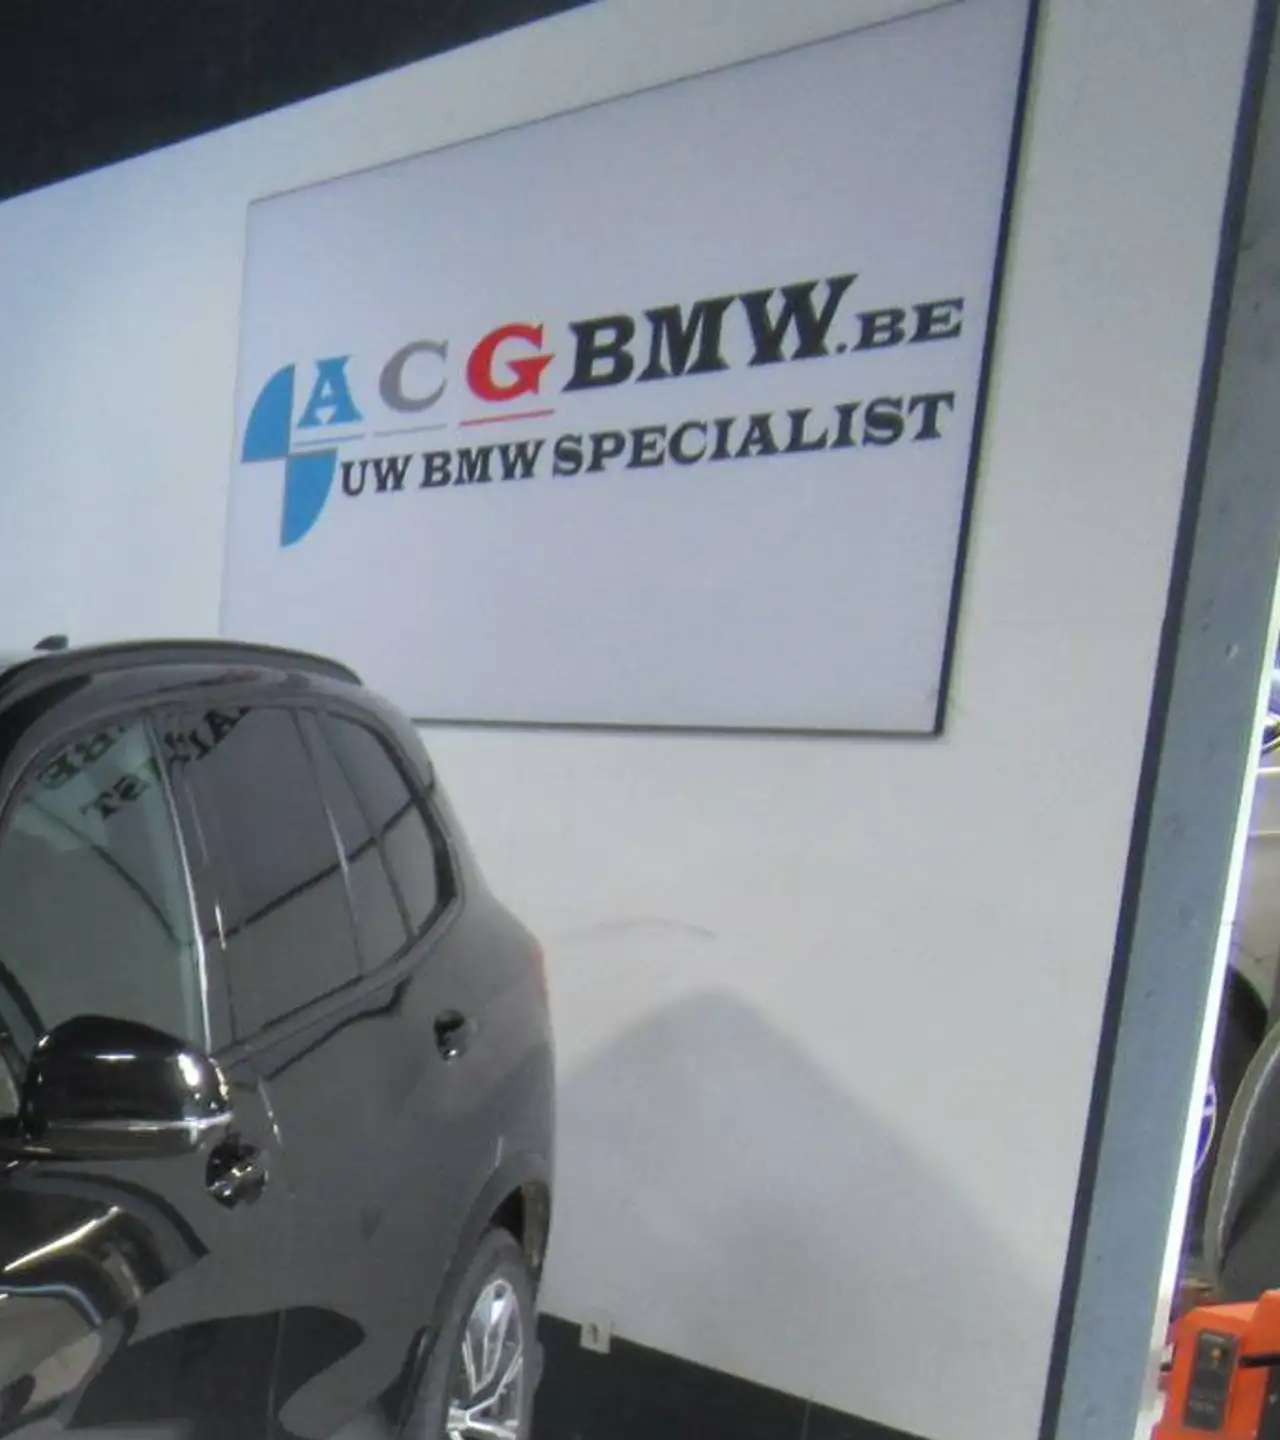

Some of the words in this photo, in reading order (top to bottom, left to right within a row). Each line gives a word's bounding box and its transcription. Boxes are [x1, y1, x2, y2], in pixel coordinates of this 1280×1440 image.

[341, 454, 413, 497] UW
[419, 439, 546, 489] BMW
[552, 391, 956, 479] SPECIALIST
